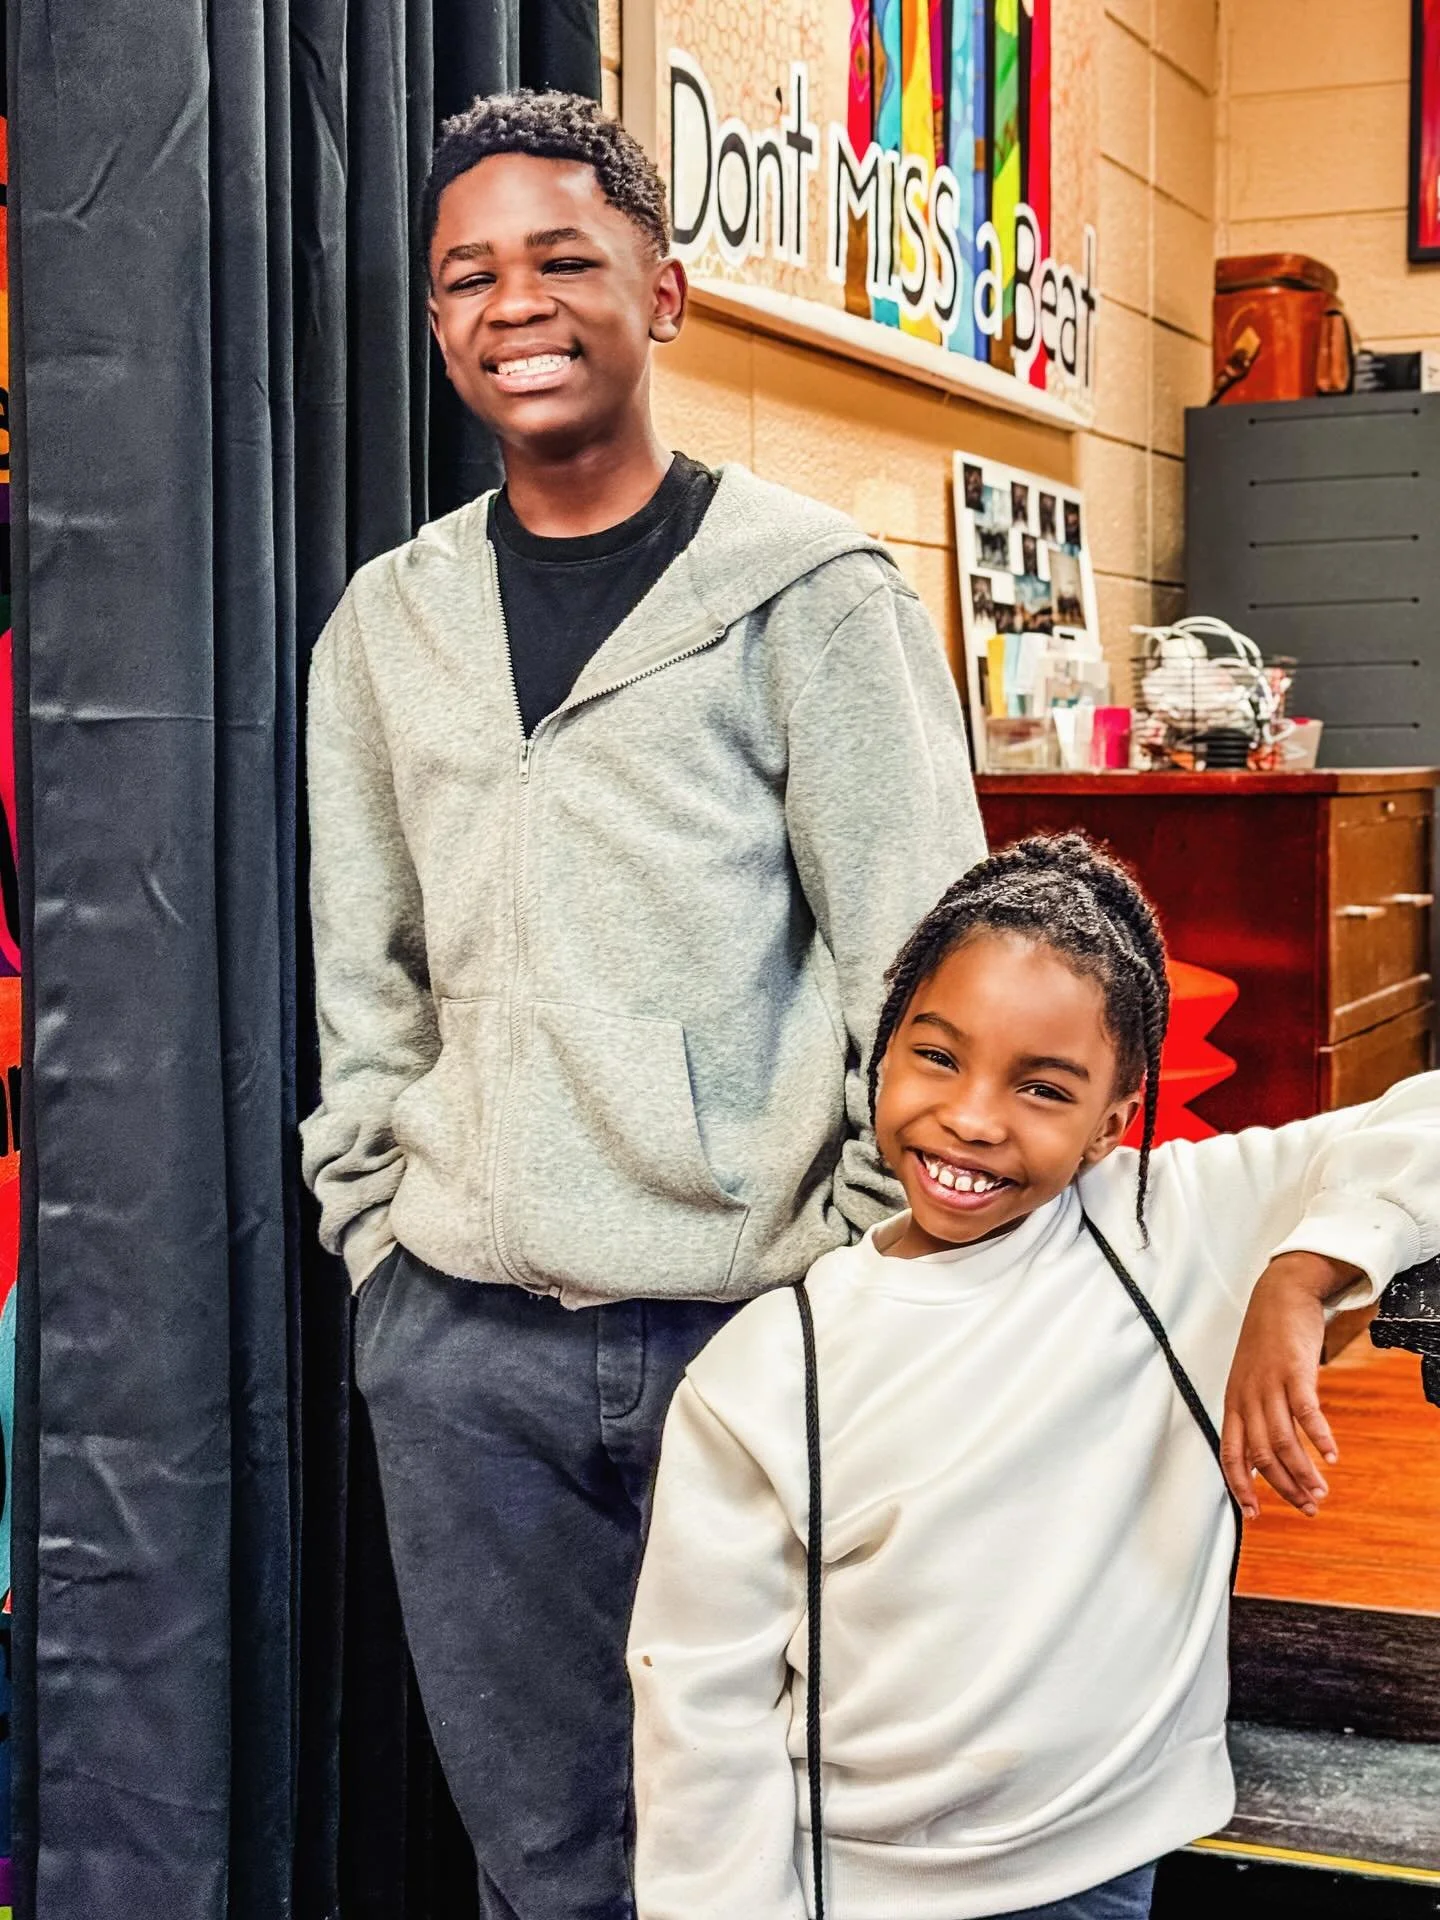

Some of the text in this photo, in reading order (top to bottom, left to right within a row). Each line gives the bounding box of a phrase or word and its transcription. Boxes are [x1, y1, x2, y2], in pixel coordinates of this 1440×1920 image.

[670, 65, 813, 255] Don't
[974, 220, 1003, 340] a
[1012, 214, 1096, 389] Beat
